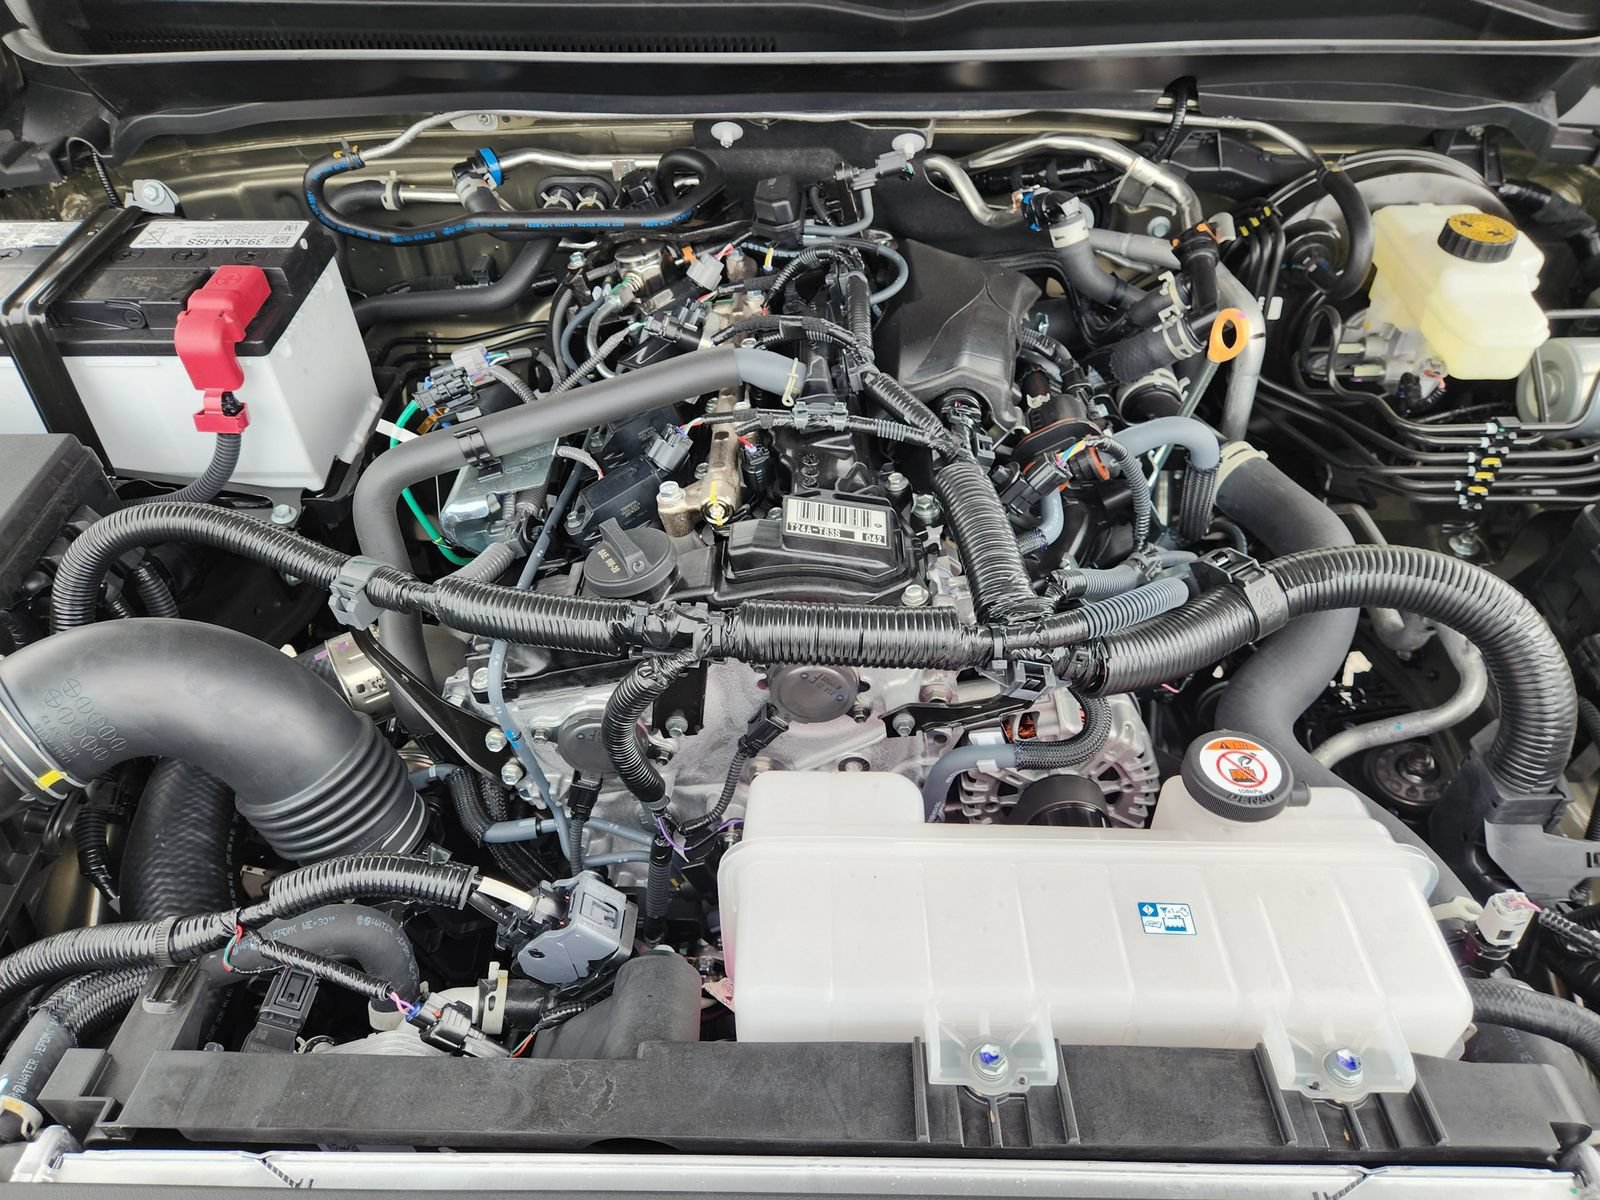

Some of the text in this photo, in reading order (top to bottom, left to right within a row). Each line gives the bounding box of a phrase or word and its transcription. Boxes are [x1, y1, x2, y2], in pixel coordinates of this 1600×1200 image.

[186, 237, 266, 246] 395LN4-ISS
[789, 522, 883, 544] T24A-T83S 042
[1226, 793, 1275, 805] DENSO
[18, 1058, 40, 1090] WATER
